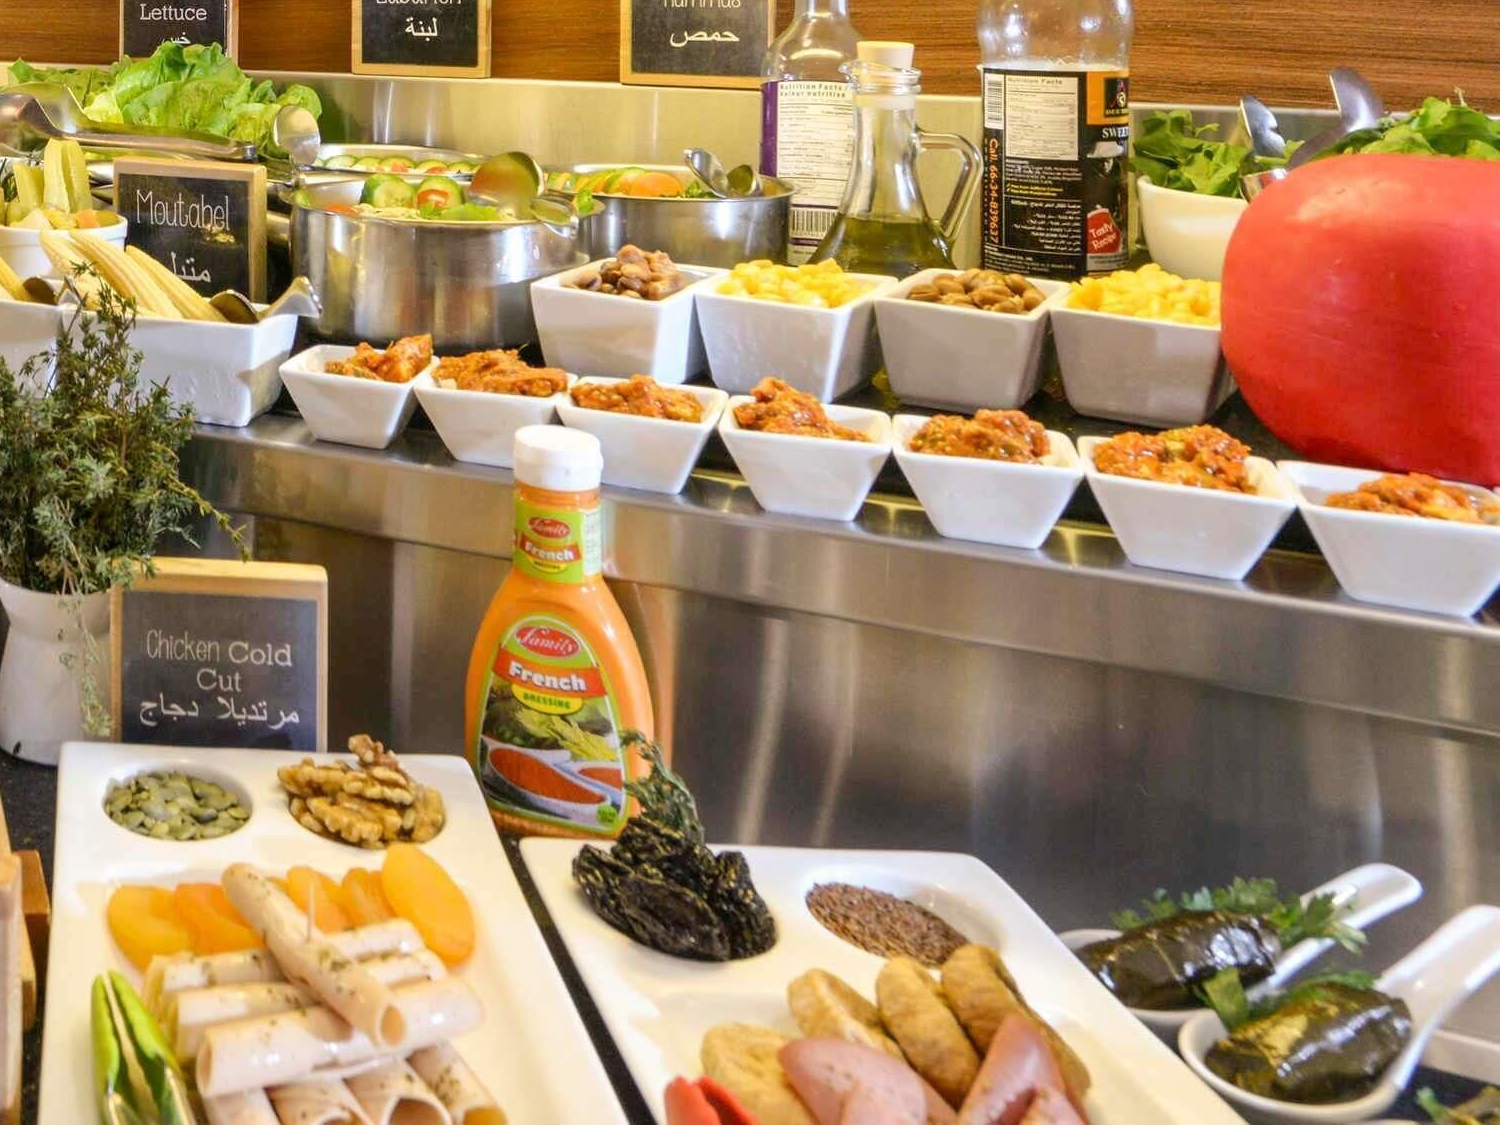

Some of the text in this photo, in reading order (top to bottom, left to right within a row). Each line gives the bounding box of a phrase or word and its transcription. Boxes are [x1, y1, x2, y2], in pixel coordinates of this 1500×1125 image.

[139, 3, 207, 21] Lettuce
[405, 17, 439, 41] لبنة
[670, 28, 740, 47] حمص
[136, 189, 230, 231] Moutabel
[524, 541, 574, 562] French
[146, 629, 293, 667] Chicken Cold
[196, 668, 242, 692] Cut
[509, 660, 587, 692] French
[139, 693, 199, 726] دجاج
[523, 692, 571, 709] DRESSING
